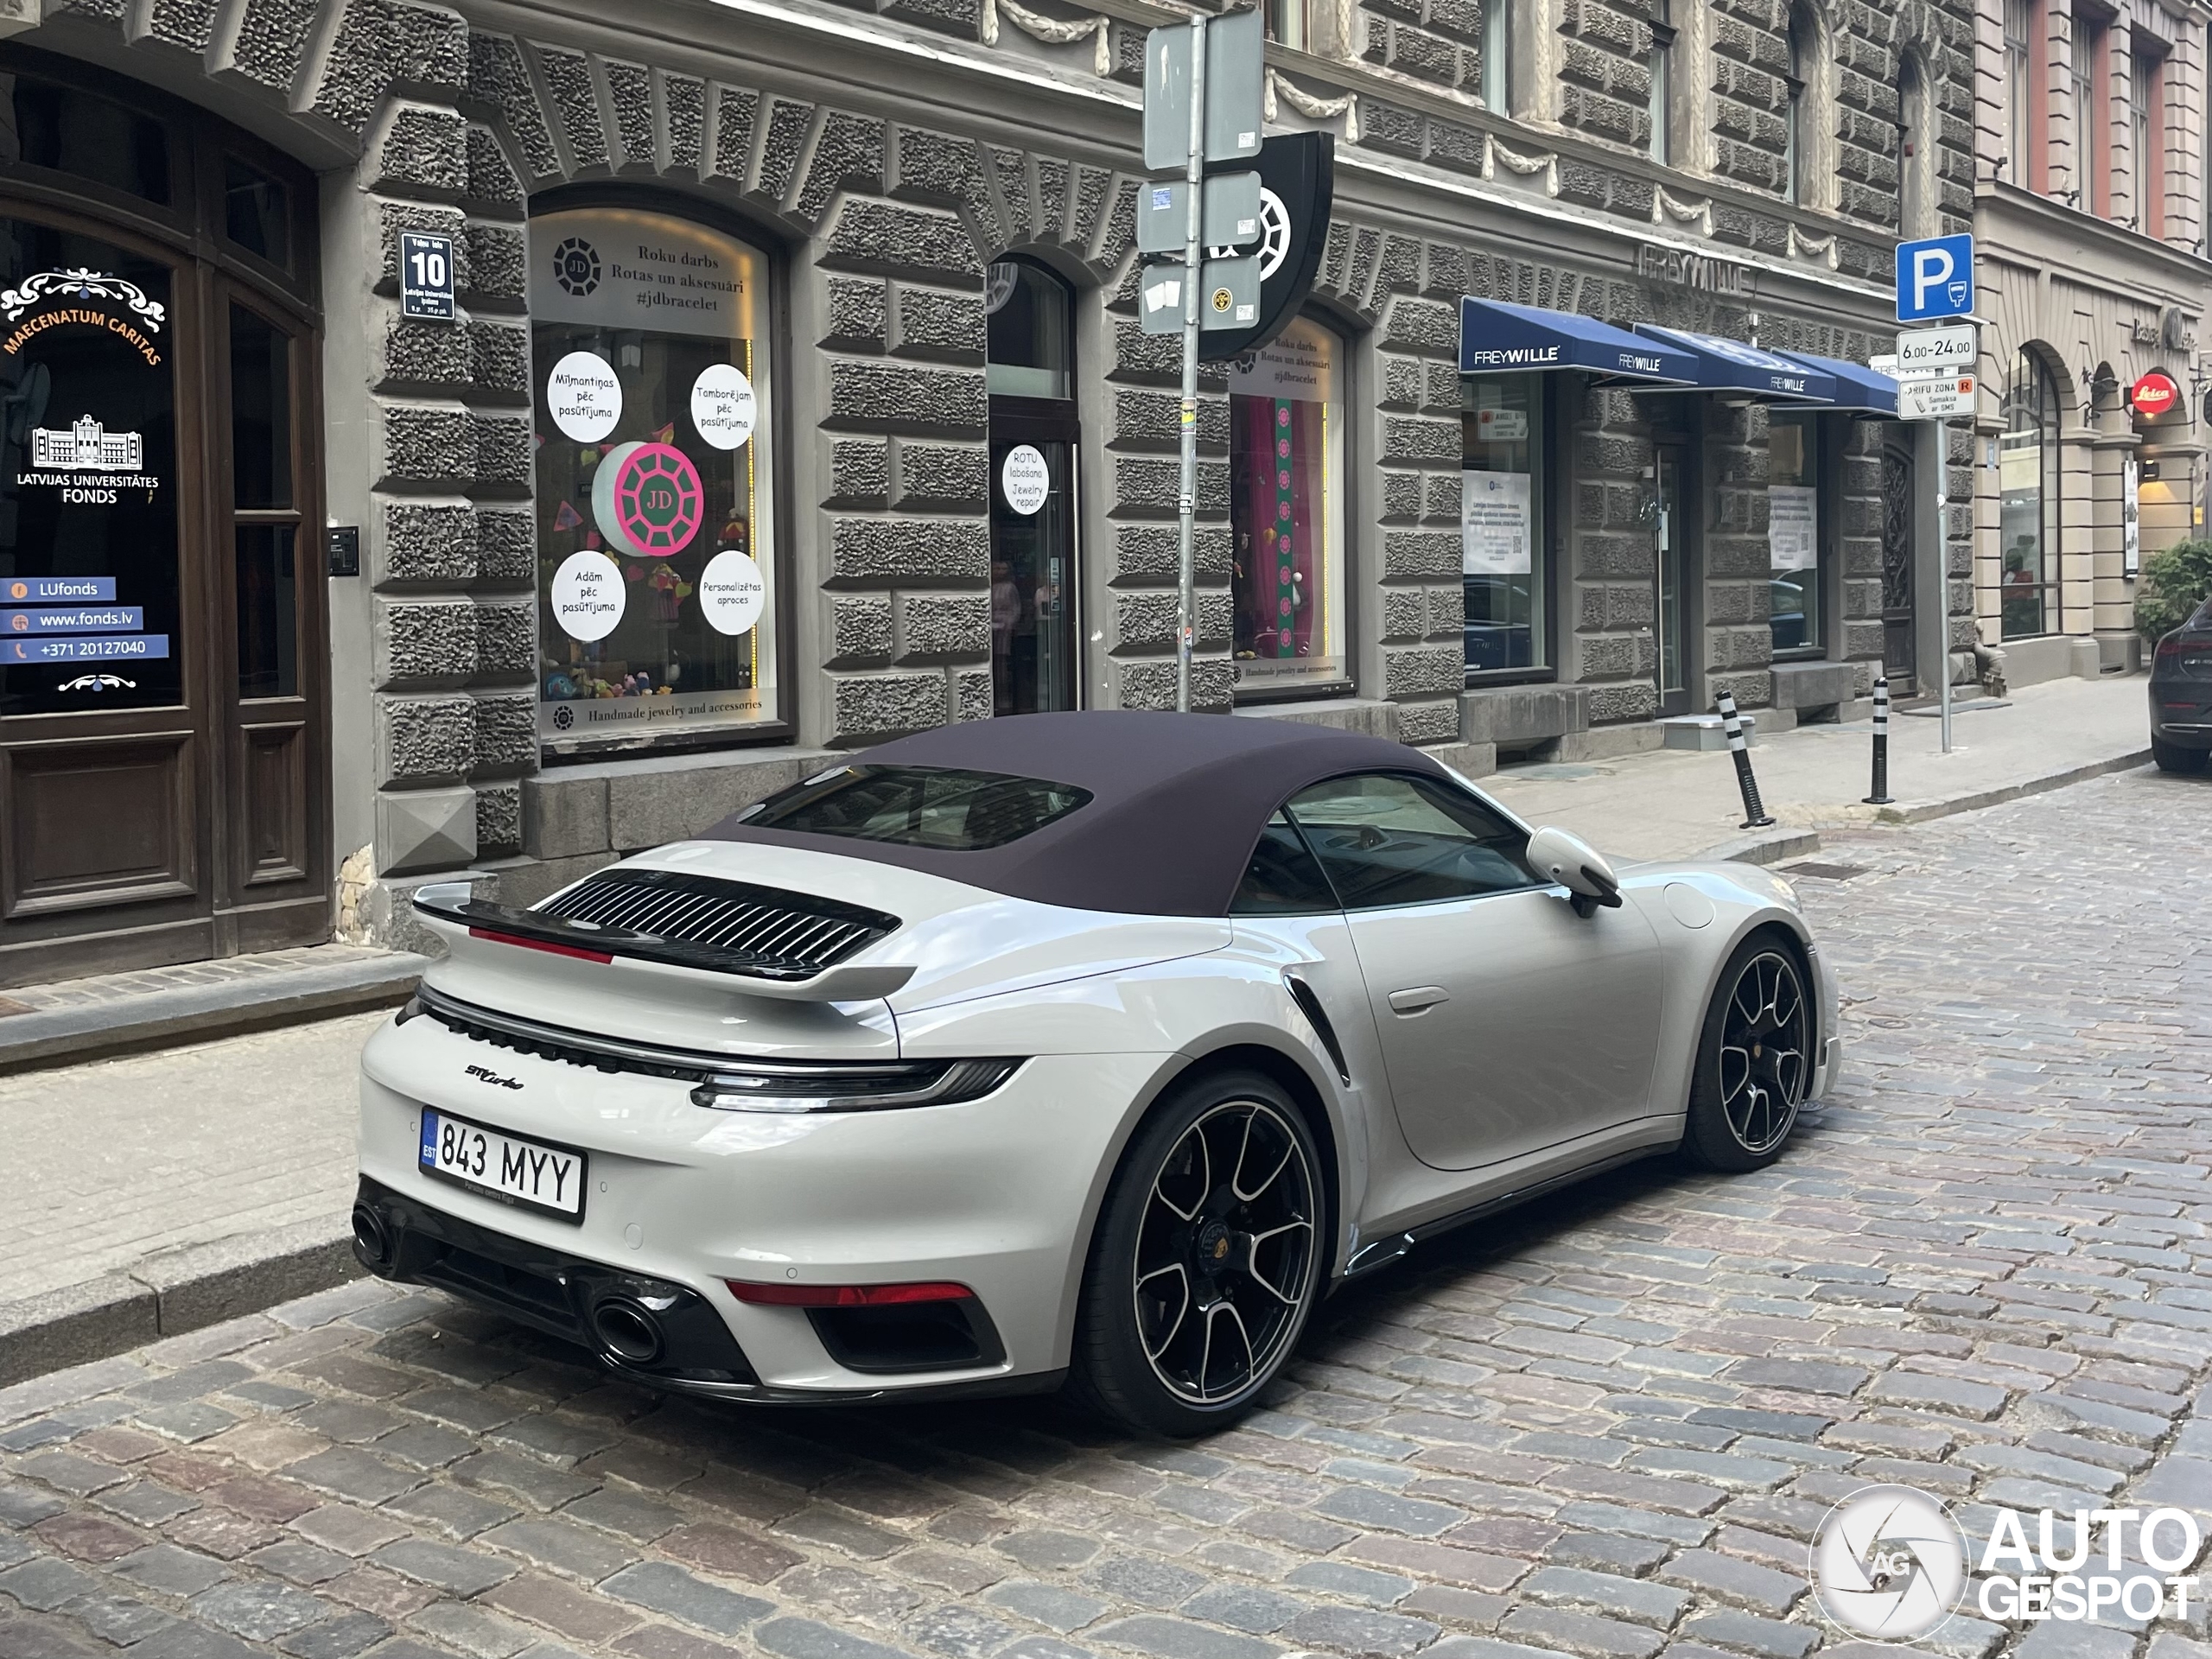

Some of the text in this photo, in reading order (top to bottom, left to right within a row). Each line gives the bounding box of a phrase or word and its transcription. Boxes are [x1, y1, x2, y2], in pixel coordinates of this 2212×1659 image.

[638, 245, 719, 269] Roku darbs
[410, 251, 446, 288] 10
[569, 260, 587, 274] JD
[612, 264, 653, 283] Rotas
[658, 274, 676, 285] un
[1914, 248, 1955, 311] P
[636, 290, 718, 312] #jdbracelet
[3, 309, 162, 366] MAECENATUM CARITAS
[1296, 340, 1317, 353] darbs
[1261, 351, 1282, 363] Rotas
[1284, 357, 1294, 365] un
[556, 373, 613, 390] Mīļmantiņas
[1274, 372, 1317, 385] #jdbracelet
[696, 386, 752, 403] Tamborējam
[1935, 384, 1955, 393] ZONA
[1961, 382, 1969, 391] R
[2135, 385, 2170, 402] Leica
[576, 391, 594, 404] pēc
[1929, 396, 1956, 404] Samaksa
[559, 406, 613, 420] pasūtījuma
[717, 403, 732, 416] pēc
[701, 417, 748, 430] pasūtījuma
[1014, 452, 1038, 464] ROTU
[1009, 467, 1042, 479] labošana
[17, 474, 158, 488] LATVIJAS UNIVERSITĀTES
[63, 489, 118, 505] FONDS
[1012, 484, 1043, 498] Jewelry
[646, 491, 673, 510] JD
[1016, 497, 1039, 510] repair
[575, 571, 603, 582] Adām
[40, 582, 98, 596] LUfonds
[581, 587, 597, 600] pēc
[703, 582, 762, 593] Personalizētas
[563, 601, 616, 615] pasūtījuma
[717, 596, 748, 607] aproces
[41, 612, 133, 626] www.fonds.lv
[41, 640, 146, 658] +371 20127040
[1297, 665, 1306, 674] and
[588, 699, 762, 722] Handmade jewelry and accessories
[423, 1144, 436, 1159] EST
[442, 1123, 572, 1202] 843 MYY
